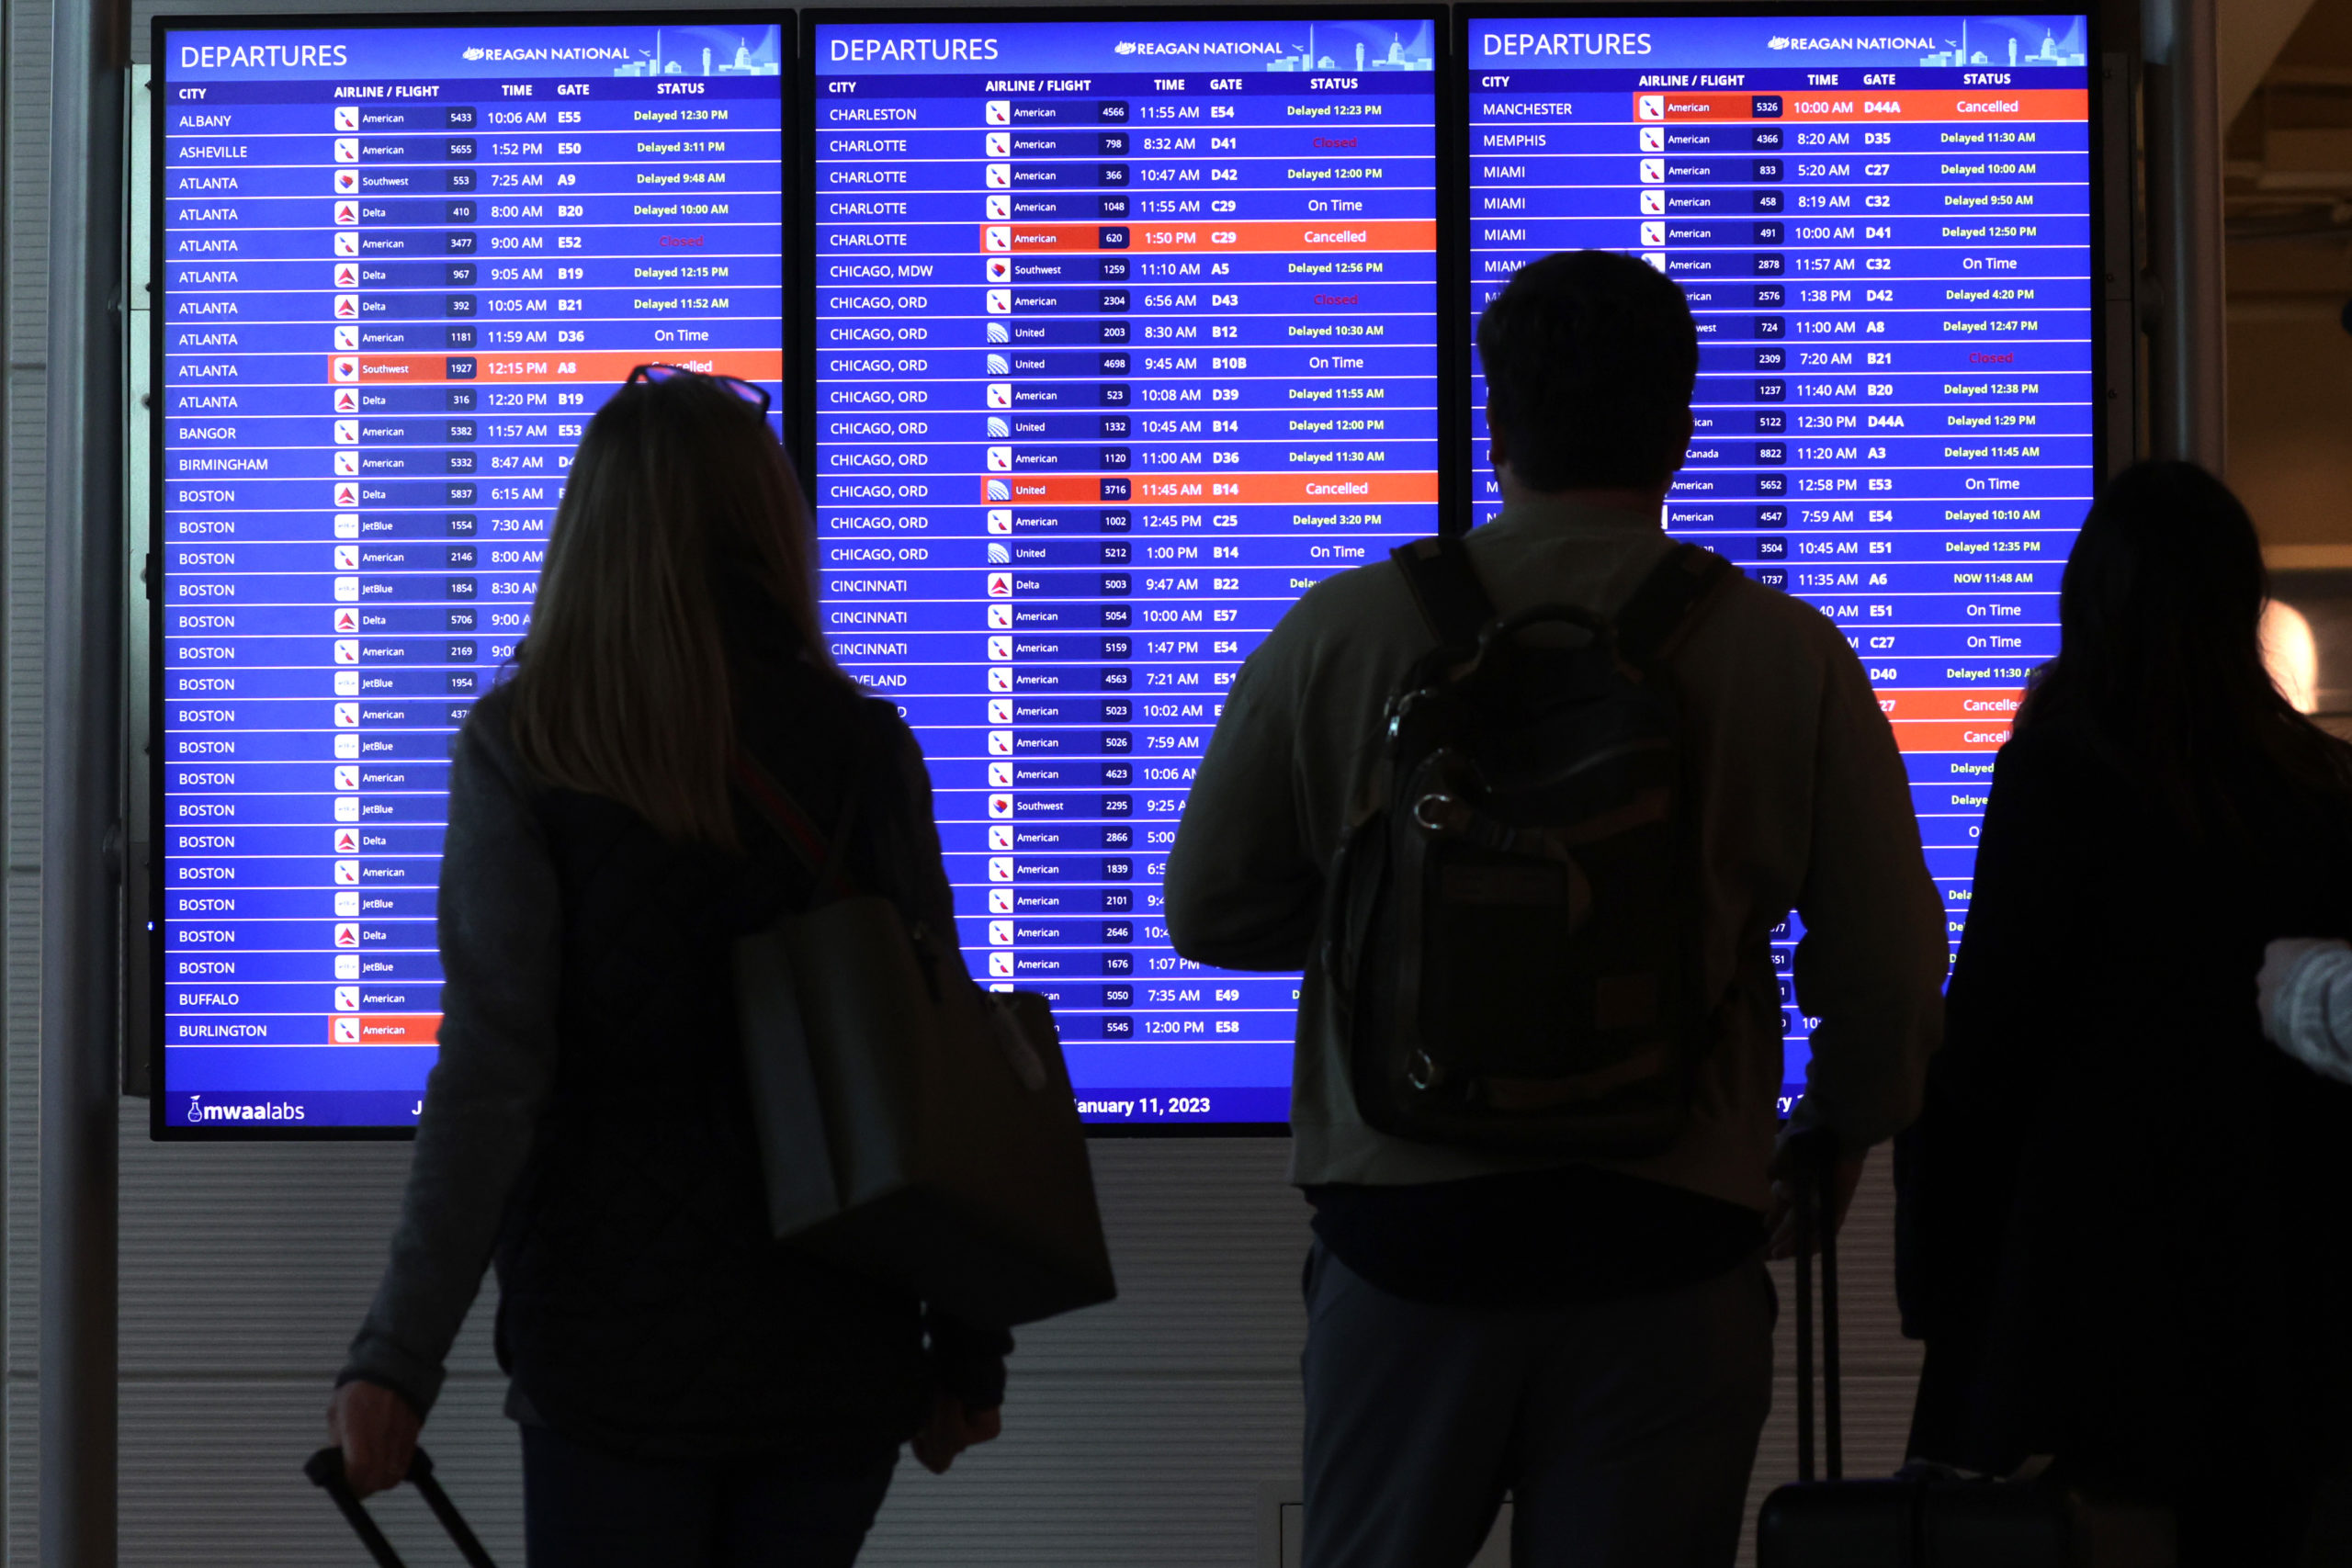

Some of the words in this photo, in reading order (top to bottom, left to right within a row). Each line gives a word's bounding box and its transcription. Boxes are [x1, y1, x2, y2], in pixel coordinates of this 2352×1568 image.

[831, 39, 999, 62] DEPARTURES
[1137, 42, 1200, 55] REAGAN
[1204, 42, 1283, 54] NATIONAL
[1484, 33, 1652, 56] DEPARTURES
[1791, 38, 1853, 51] REAGAN
[1857, 37, 1936, 50] NATIONAL
[181, 44, 347, 68] DEPARTURES
[485, 48, 548, 61] REAGAN
[550, 47, 630, 60] NATIONAL
[828, 81, 857, 93] CITY
[985, 80, 1035, 92] AIRLINE
[1037, 80, 1045, 92] /
[1046, 79, 1091, 92] FLIGHT
[1153, 79, 1185, 91] TIME
[1210, 78, 1243, 90] GATE
[1310, 77, 1359, 90] STATUS
[1482, 75, 1510, 87] CITY
[1638, 74, 1690, 86] AIRLINE
[1691, 74, 1698, 86] /
[1701, 74, 1746, 86] FLIGHT
[1807, 73, 1838, 85] TIME
[1863, 73, 1896, 85] GATE
[1963, 73, 2011, 85] STATUS
[178, 88, 207, 99] CITY
[334, 85, 384, 98] AIRLINE
[386, 85, 393, 97] /
[395, 85, 440, 97] FLIGHT
[501, 85, 533, 96] TIME
[557, 84, 590, 96] GATE
[657, 83, 705, 95] STATUS
[830, 108, 917, 121] CHARLESTON
[1013, 107, 1057, 118] American
[1102, 107, 1125, 117] 4566
[1140, 106, 1175, 118] 11:55
[1178, 106, 1200, 118] AM
[1210, 106, 1235, 118] E54
[1287, 105, 1331, 118] Delayed
[1333, 105, 1363, 116] 12:23
[1364, 105, 1382, 115] PM
[1483, 103, 1573, 116] MANCHESTER
[1668, 103, 1710, 112] American
[1756, 102, 1779, 112] 5326
[1793, 101, 1829, 114] 10:00
[1831, 101, 1853, 114] AM
[1864, 101, 1901, 114] D44A
[1956, 99, 2018, 113] Cancelled
[178, 115, 232, 128] ALBANY
[362, 114, 404, 123] American
[450, 113, 472, 122] 5433
[487, 111, 523, 124] 10:06
[525, 111, 547, 124] AM
[558, 111, 582, 124] E55
[633, 109, 678, 123] Delayed
[680, 109, 709, 120] 12:30
[710, 109, 729, 120] PM
[1484, 134, 1546, 147] MEMPHIS
[1668, 135, 1711, 144] American
[1756, 134, 1779, 144] 4366
[1797, 132, 1826, 145] 8:20
[1827, 132, 1849, 145] AM
[1864, 132, 1892, 145] D35
[1940, 131, 1984, 146] Delayed
[1986, 132, 2016, 142] 11:30
[2017, 132, 2036, 142] AM
[178, 239, 239, 252] ATLANTA
[362, 239, 404, 249] American
[450, 238, 472, 248] 3477
[491, 236, 519, 249] 9:00
[521, 236, 543, 249] AM
[558, 236, 582, 249] E52
[659, 234, 705, 247] Closed
[830, 265, 895, 279] CHICAGO,
[898, 265, 933, 277] MDW
[1014, 265, 1062, 275] Southwest
[1103, 265, 1125, 275] 1259
[1141, 263, 1177, 276] 11:10
[1179, 263, 1201, 276] AM
[1211, 263, 1230, 276] A5
[1288, 262, 1332, 276] Delayed
[1335, 262, 1363, 273] 12:56
[1365, 262, 1384, 273] PM
[1758, 354, 1781, 364] 2309
[1800, 353, 1828, 366] 7:20
[1830, 352, 1852, 365] AM
[1867, 352, 1892, 365] B21
[1969, 352, 2015, 364] Closed
[179, 427, 236, 440] BANGOR
[362, 427, 404, 436] American
[450, 426, 472, 436] 5382
[488, 424, 524, 437] 11:57
[526, 424, 548, 437] AM
[558, 424, 582, 436] E53
[1685, 448, 1719, 458] Canada
[1759, 448, 1781, 458] 8822
[1797, 447, 1833, 460] 11:20
[1835, 446, 1858, 459] AM
[1867, 446, 1886, 459] A3
[1944, 446, 1988, 460] Delayed
[1991, 446, 2019, 457] 11:45
[2021, 446, 2041, 457] AM
[831, 485, 895, 499] CHICAGO,
[898, 485, 929, 498] ORD
[1015, 485, 1046, 495] United
[1104, 485, 1126, 494] 3716
[1142, 483, 1178, 496] 11:45
[1180, 483, 1202, 496] AM
[1213, 483, 1239, 496] B14
[1306, 481, 1368, 495] Cancelled
[179, 521, 235, 534] BOSTON
[361, 521, 393, 533] JetBlue
[451, 521, 472, 530] 1554
[491, 519, 520, 532] 7:30
[521, 519, 544, 531] AM
[831, 580, 907, 592] CINCINNATI
[1016, 580, 1040, 590] Delta
[1105, 580, 1127, 589] 5003
[1146, 578, 1174, 591] 9:47
[1176, 578, 1198, 591] AM
[1213, 578, 1239, 591] B22
[1761, 575, 1783, 584] 1737
[1799, 573, 1835, 586] 11:35
[1837, 573, 1859, 586] AM
[1868, 573, 1888, 586] A6
[1953, 573, 1983, 584] NOW
[1984, 572, 2013, 583] 11:48
[2014, 572, 2033, 583] AM
[179, 647, 235, 660] BOSTON
[362, 647, 405, 657] American
[450, 647, 473, 656] 2169
[1870, 668, 1897, 681] D40
[1946, 667, 1991, 682] Delayed
[1993, 668, 2022, 678] 11:30
[179, 773, 235, 785] BOSTON
[362, 773, 405, 783] American
[1016, 801, 1064, 811] Southwest
[1105, 801, 1128, 810] 2295
[179, 898, 235, 911] BOSTON
[362, 898, 394, 910] JetBlue
[1017, 928, 1060, 938] American
[1106, 927, 1129, 937] 2646
[179, 993, 240, 1006] BUFFALO
[362, 994, 405, 1003] American
[179, 1024, 267, 1037] BURLINGTON
[362, 1025, 405, 1035] American
[1107, 1022, 1129, 1032] 5545
[1145, 1021, 1181, 1033] 12:00
[1183, 1021, 1204, 1033] PM
[1216, 1021, 1240, 1033] E58
[203, 1101, 305, 1120] mwaalabs
[1073, 1098, 1135, 1117] anuary
[1138, 1097, 1164, 1116] 11,
[1168, 1097, 1211, 1113] 2023
